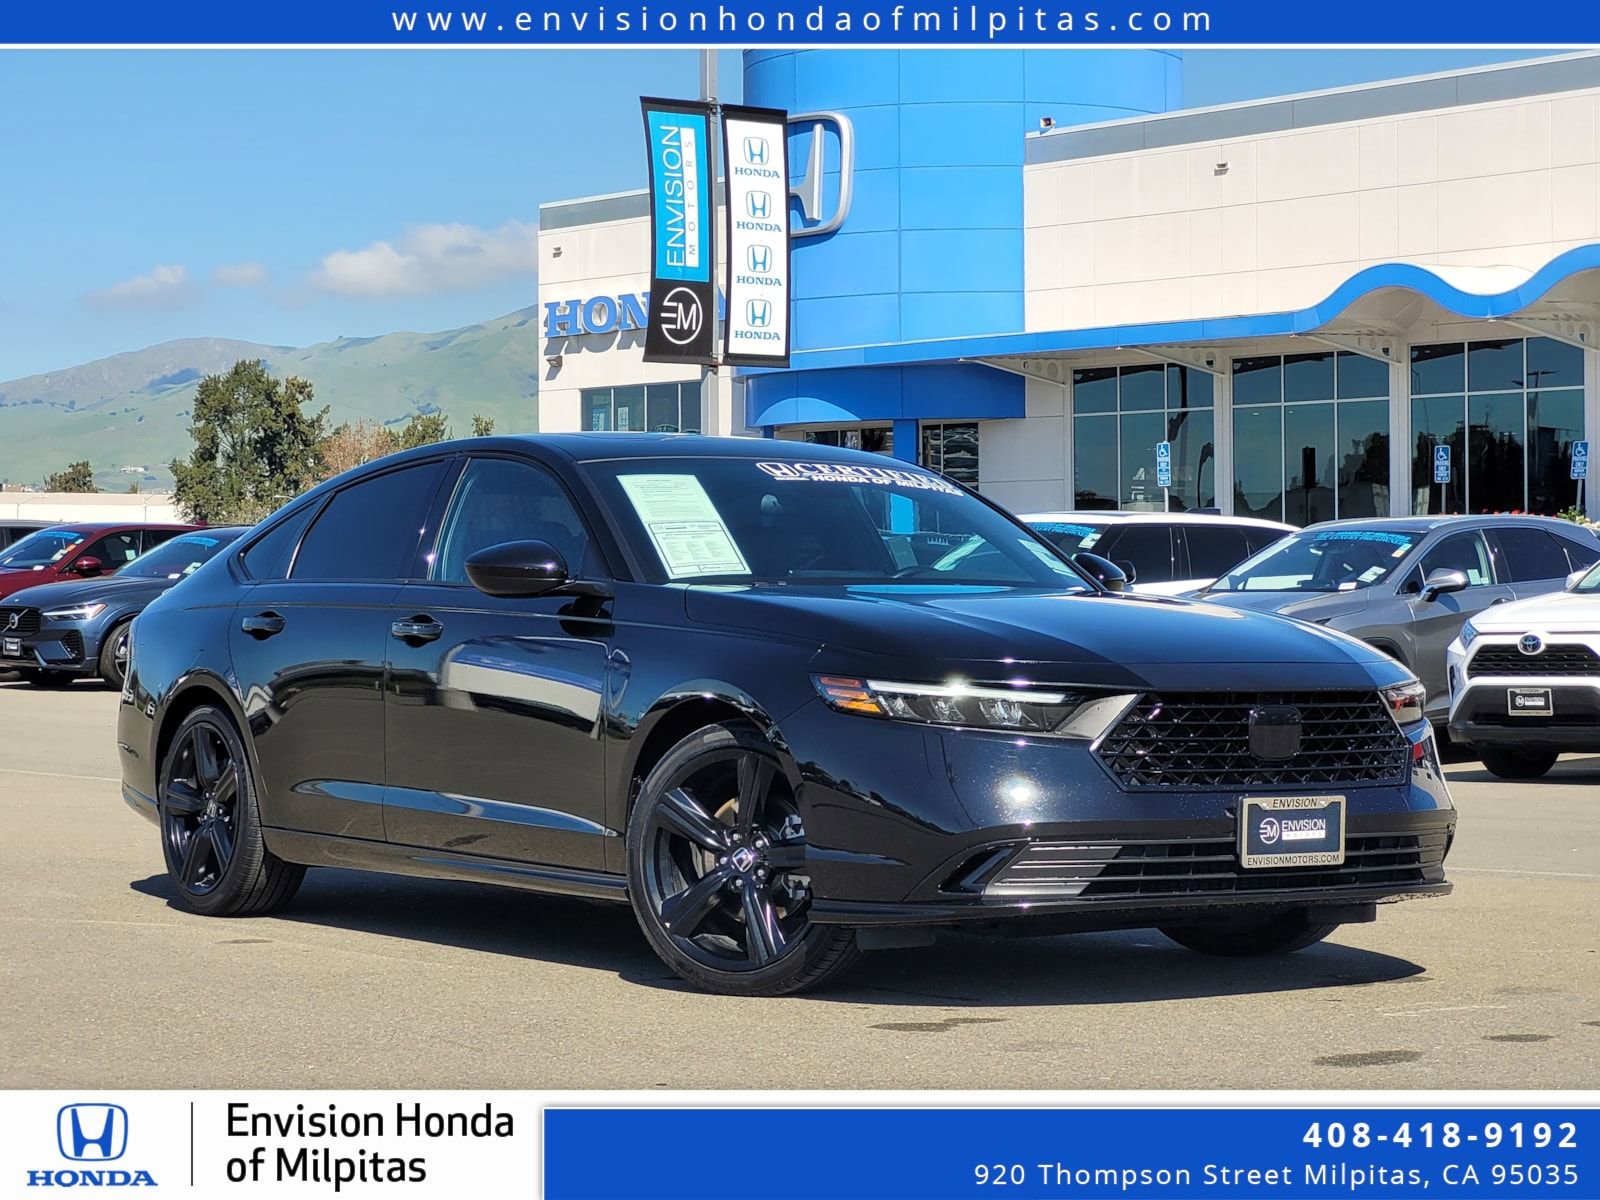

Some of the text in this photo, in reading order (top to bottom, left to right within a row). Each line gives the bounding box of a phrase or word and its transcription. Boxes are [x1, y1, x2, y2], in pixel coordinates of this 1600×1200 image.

[734, 167, 780, 179] HONDA
[660, 125, 685, 266] ENVISION
[685, 141, 696, 255] MOTORS
[736, 221, 782, 233] HONDA
[736, 275, 782, 287] HONDA
[734, 330, 781, 341] HONDA
[811, 475, 870, 484] HONDA
[872, 477, 893, 485] OF
[1272, 798, 1318, 808] ENVISION
[1282, 819, 1325, 831] ENVISION
[1247, 854, 1340, 866] ENVISIONMOTORS.COM
